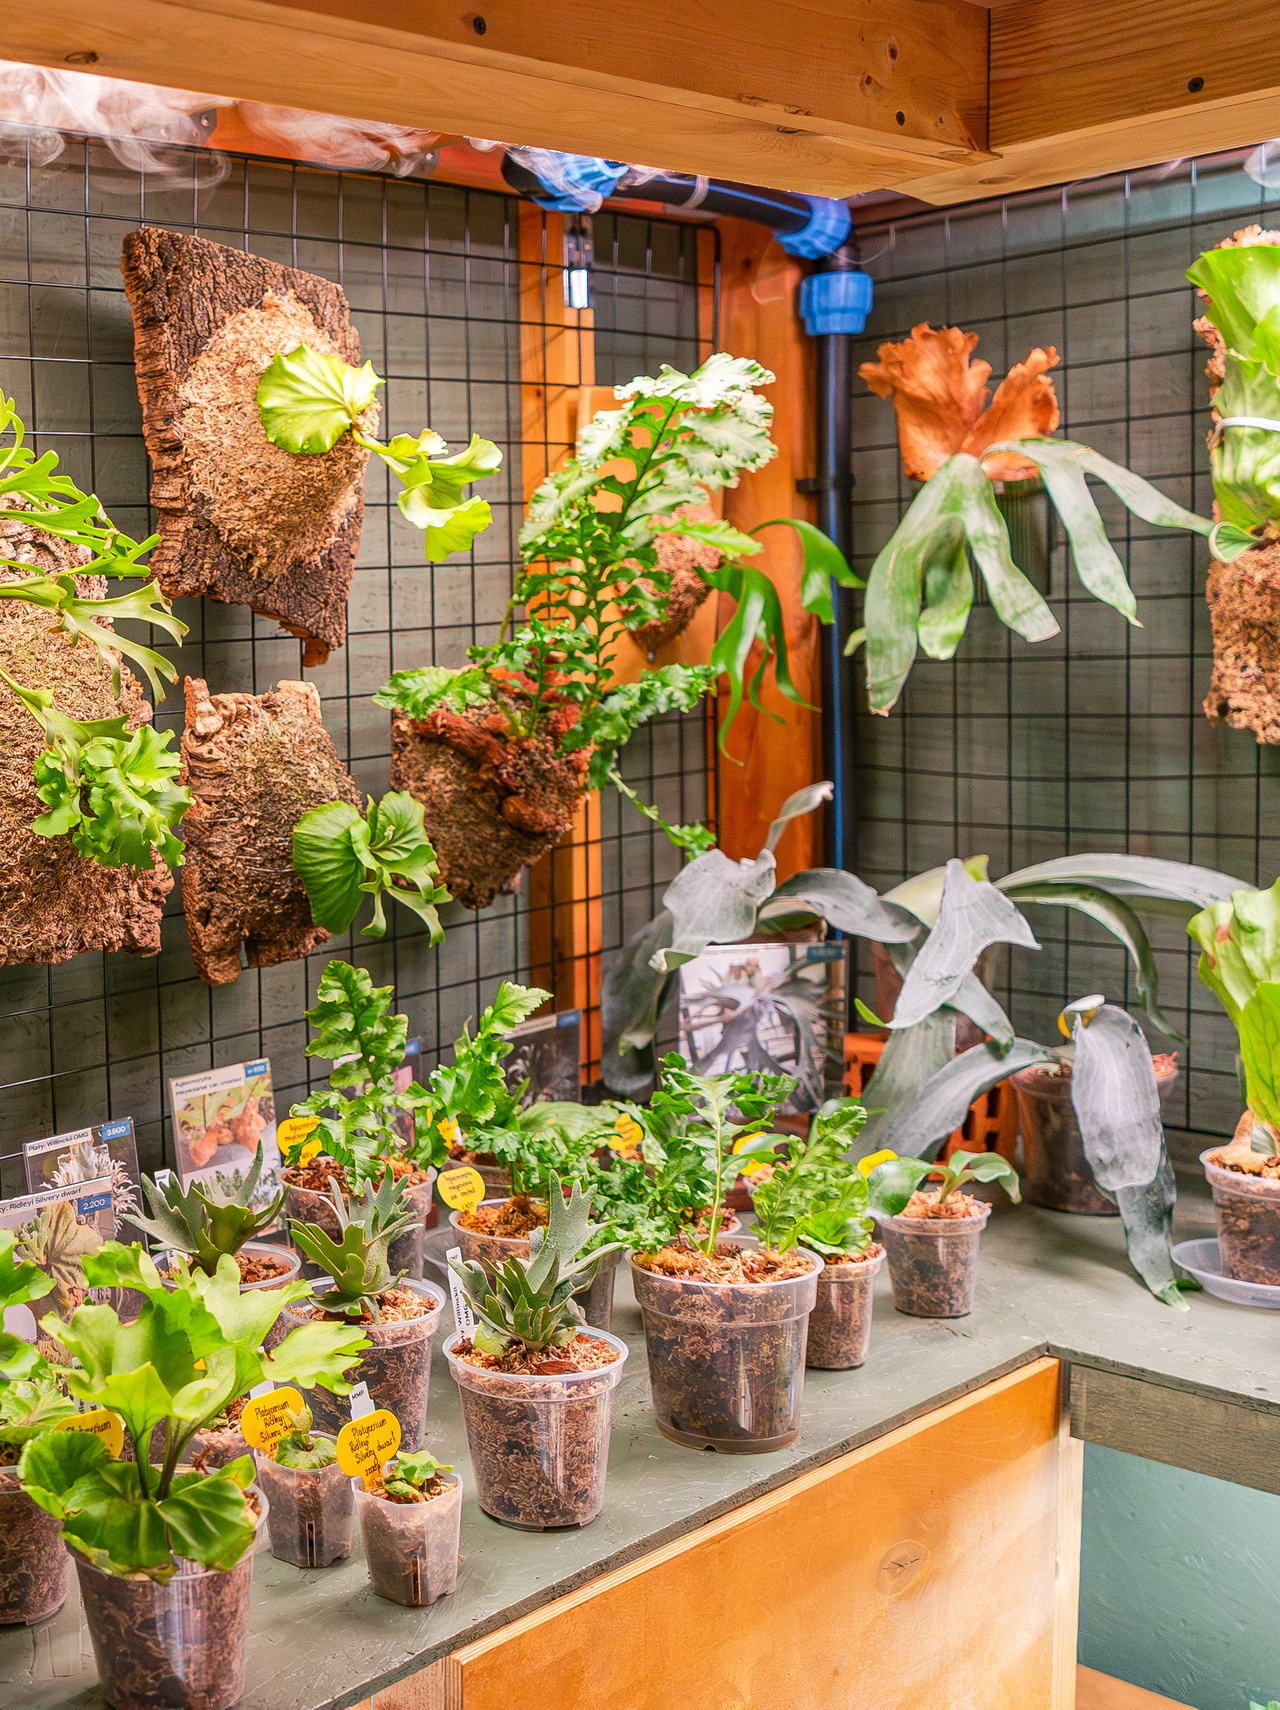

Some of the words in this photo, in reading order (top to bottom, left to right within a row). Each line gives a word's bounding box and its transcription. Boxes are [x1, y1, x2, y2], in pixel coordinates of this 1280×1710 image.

[9, 1200, 34, 1210] Ridleyi
[35, 1193, 60, 1204] Silvery
[61, 1187, 82, 1197] dwarf
[254, 1400, 290, 1421] Platycerium
[259, 1430, 281, 1444] Silvery
[351, 1418, 388, 1439] Platycerium
[354, 1450, 379, 1465] Silvery
